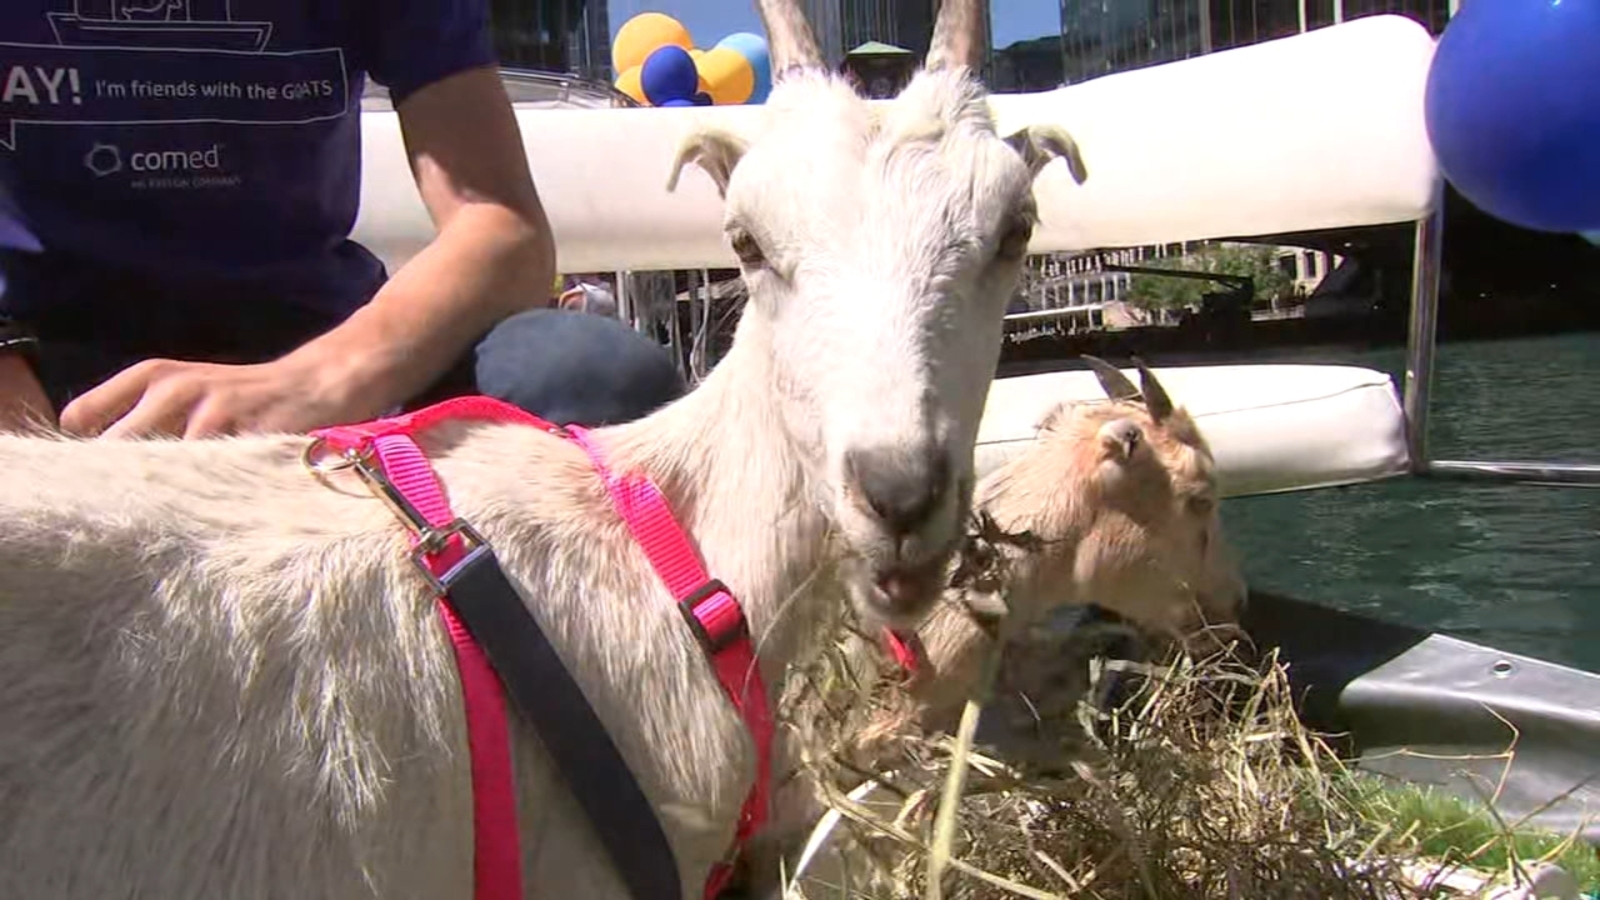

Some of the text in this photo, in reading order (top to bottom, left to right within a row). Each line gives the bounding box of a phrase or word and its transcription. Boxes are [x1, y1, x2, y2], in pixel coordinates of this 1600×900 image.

[94, 80, 126, 97] I'm
[131, 80, 196, 97] friends
[201, 80, 242, 98] with
[247, 83, 276, 99] the
[131, 144, 218, 171] comed
